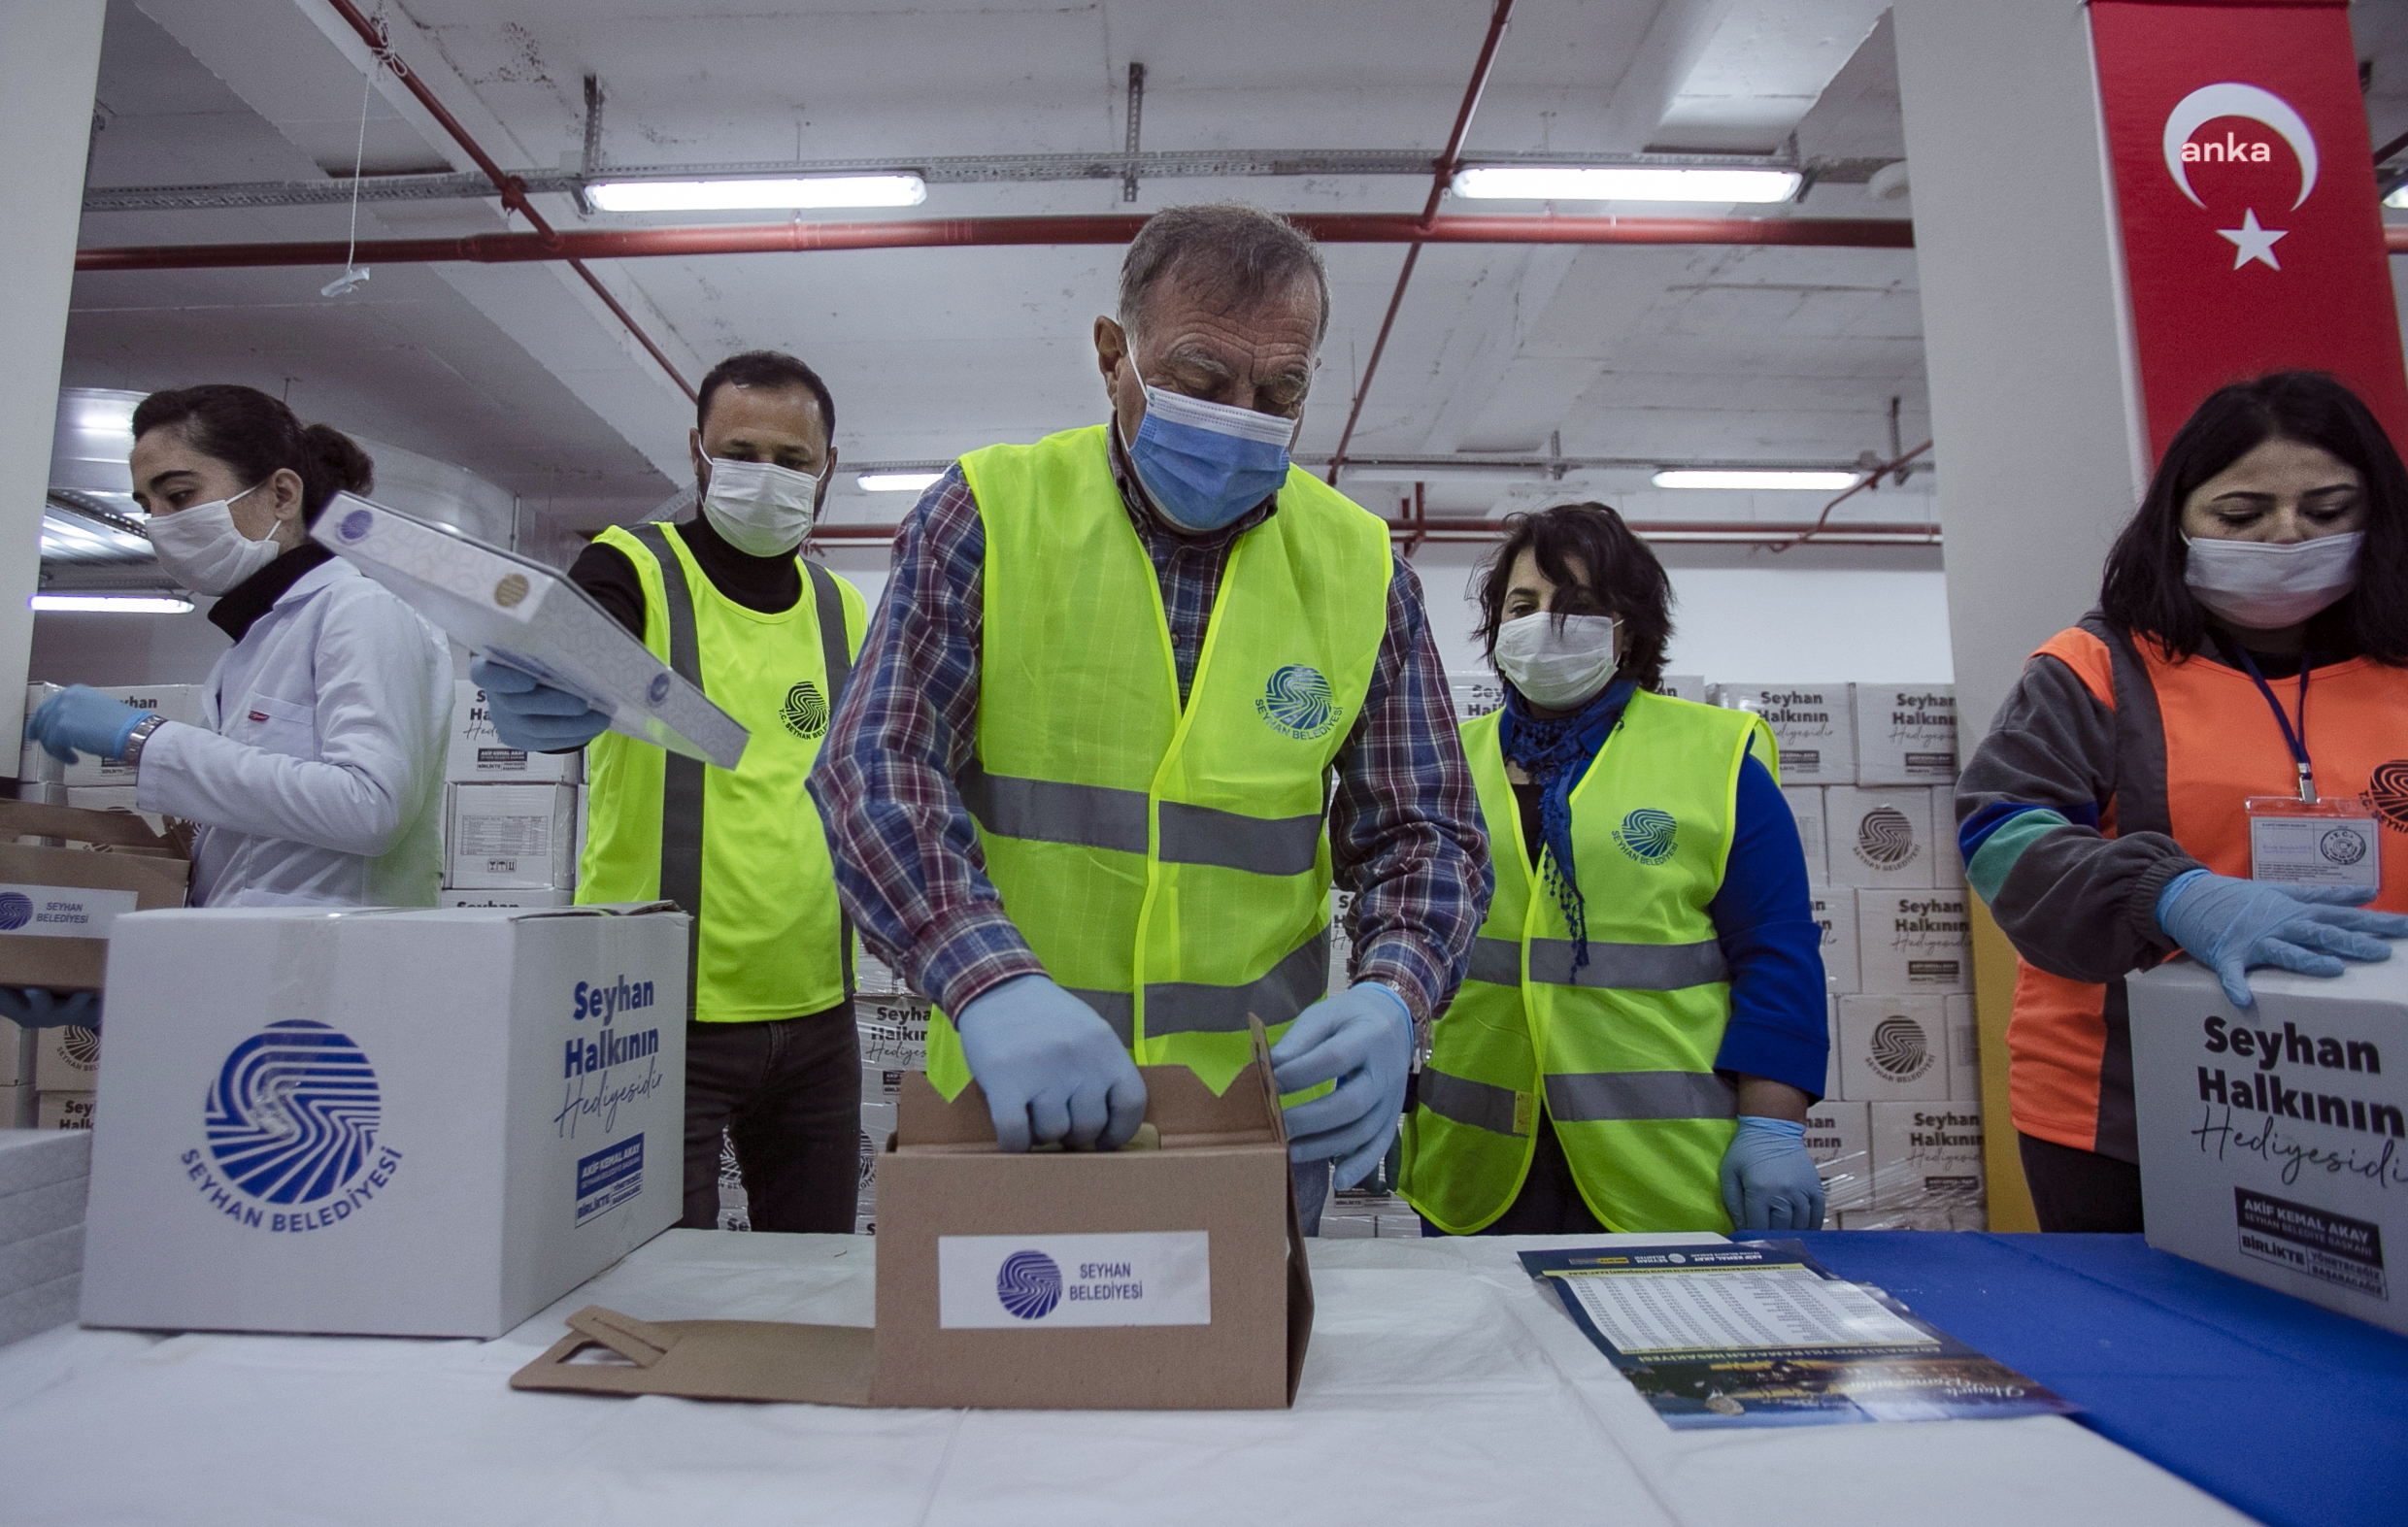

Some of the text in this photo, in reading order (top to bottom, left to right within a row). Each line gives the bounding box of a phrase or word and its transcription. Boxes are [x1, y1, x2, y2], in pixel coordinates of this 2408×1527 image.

[1760, 691, 1823, 708] Seyhan
[1255, 699, 1289, 736] SEYHAN
[1612, 830, 1639, 861] SEYHAN
[36, 913, 89, 924] BELEDİYESİ
[47, 902, 84, 912] SEYHAN
[1898, 898, 1964, 915] Seyhan
[1895, 918, 1970, 932] Halkının
[573, 974, 654, 1026] Seyhan
[876, 1006, 931, 1024] Seyha
[564, 1028, 659, 1079] Halkının
[2203, 1015, 2381, 1075] Seyhan
[554, 1055, 663, 1140] Hediyesidir
[2197, 1066, 2406, 1139] Halkının
[1914, 1112, 1981, 1131] Seyhan
[2191, 1105, 2408, 1188] Hediyesidi
[181, 1145, 403, 1233] SEYHAN BELEDİYESİ
[2244, 1199, 2369, 1244] AKİF KEMAL AKAY
[2242, 1234, 2305, 1266] BİRLİKTE
[1079, 1262, 1131, 1279] SEYHAN
[1069, 1280, 1144, 1301] BELEDİYESİ
